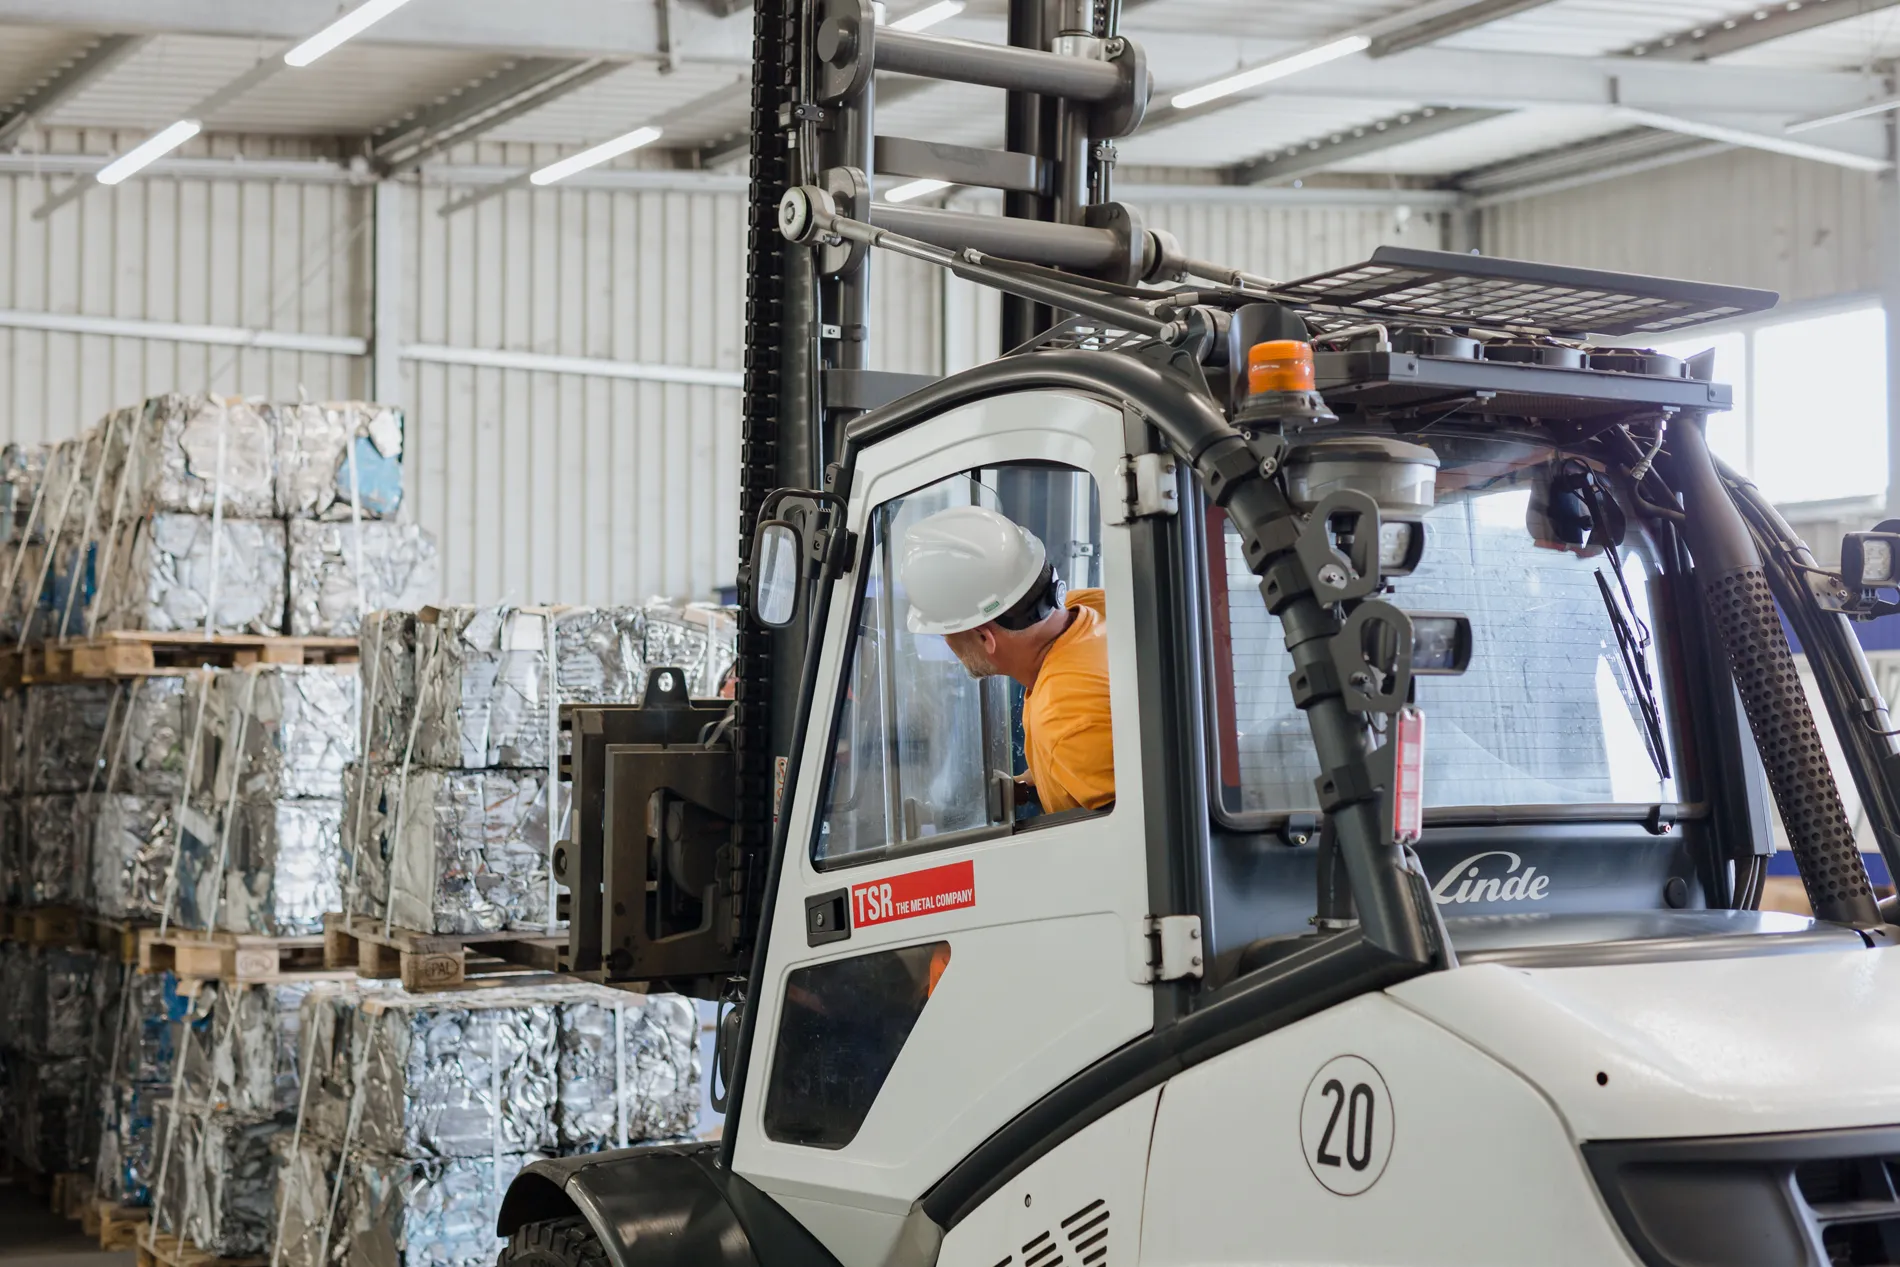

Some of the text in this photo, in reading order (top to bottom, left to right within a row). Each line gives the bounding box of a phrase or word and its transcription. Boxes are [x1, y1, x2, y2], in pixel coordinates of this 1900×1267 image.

[854, 883, 973, 922] TSR THE METAL COMPANY
[1431, 851, 1549, 904] Linde
[1317, 1079, 1374, 1171] 20
